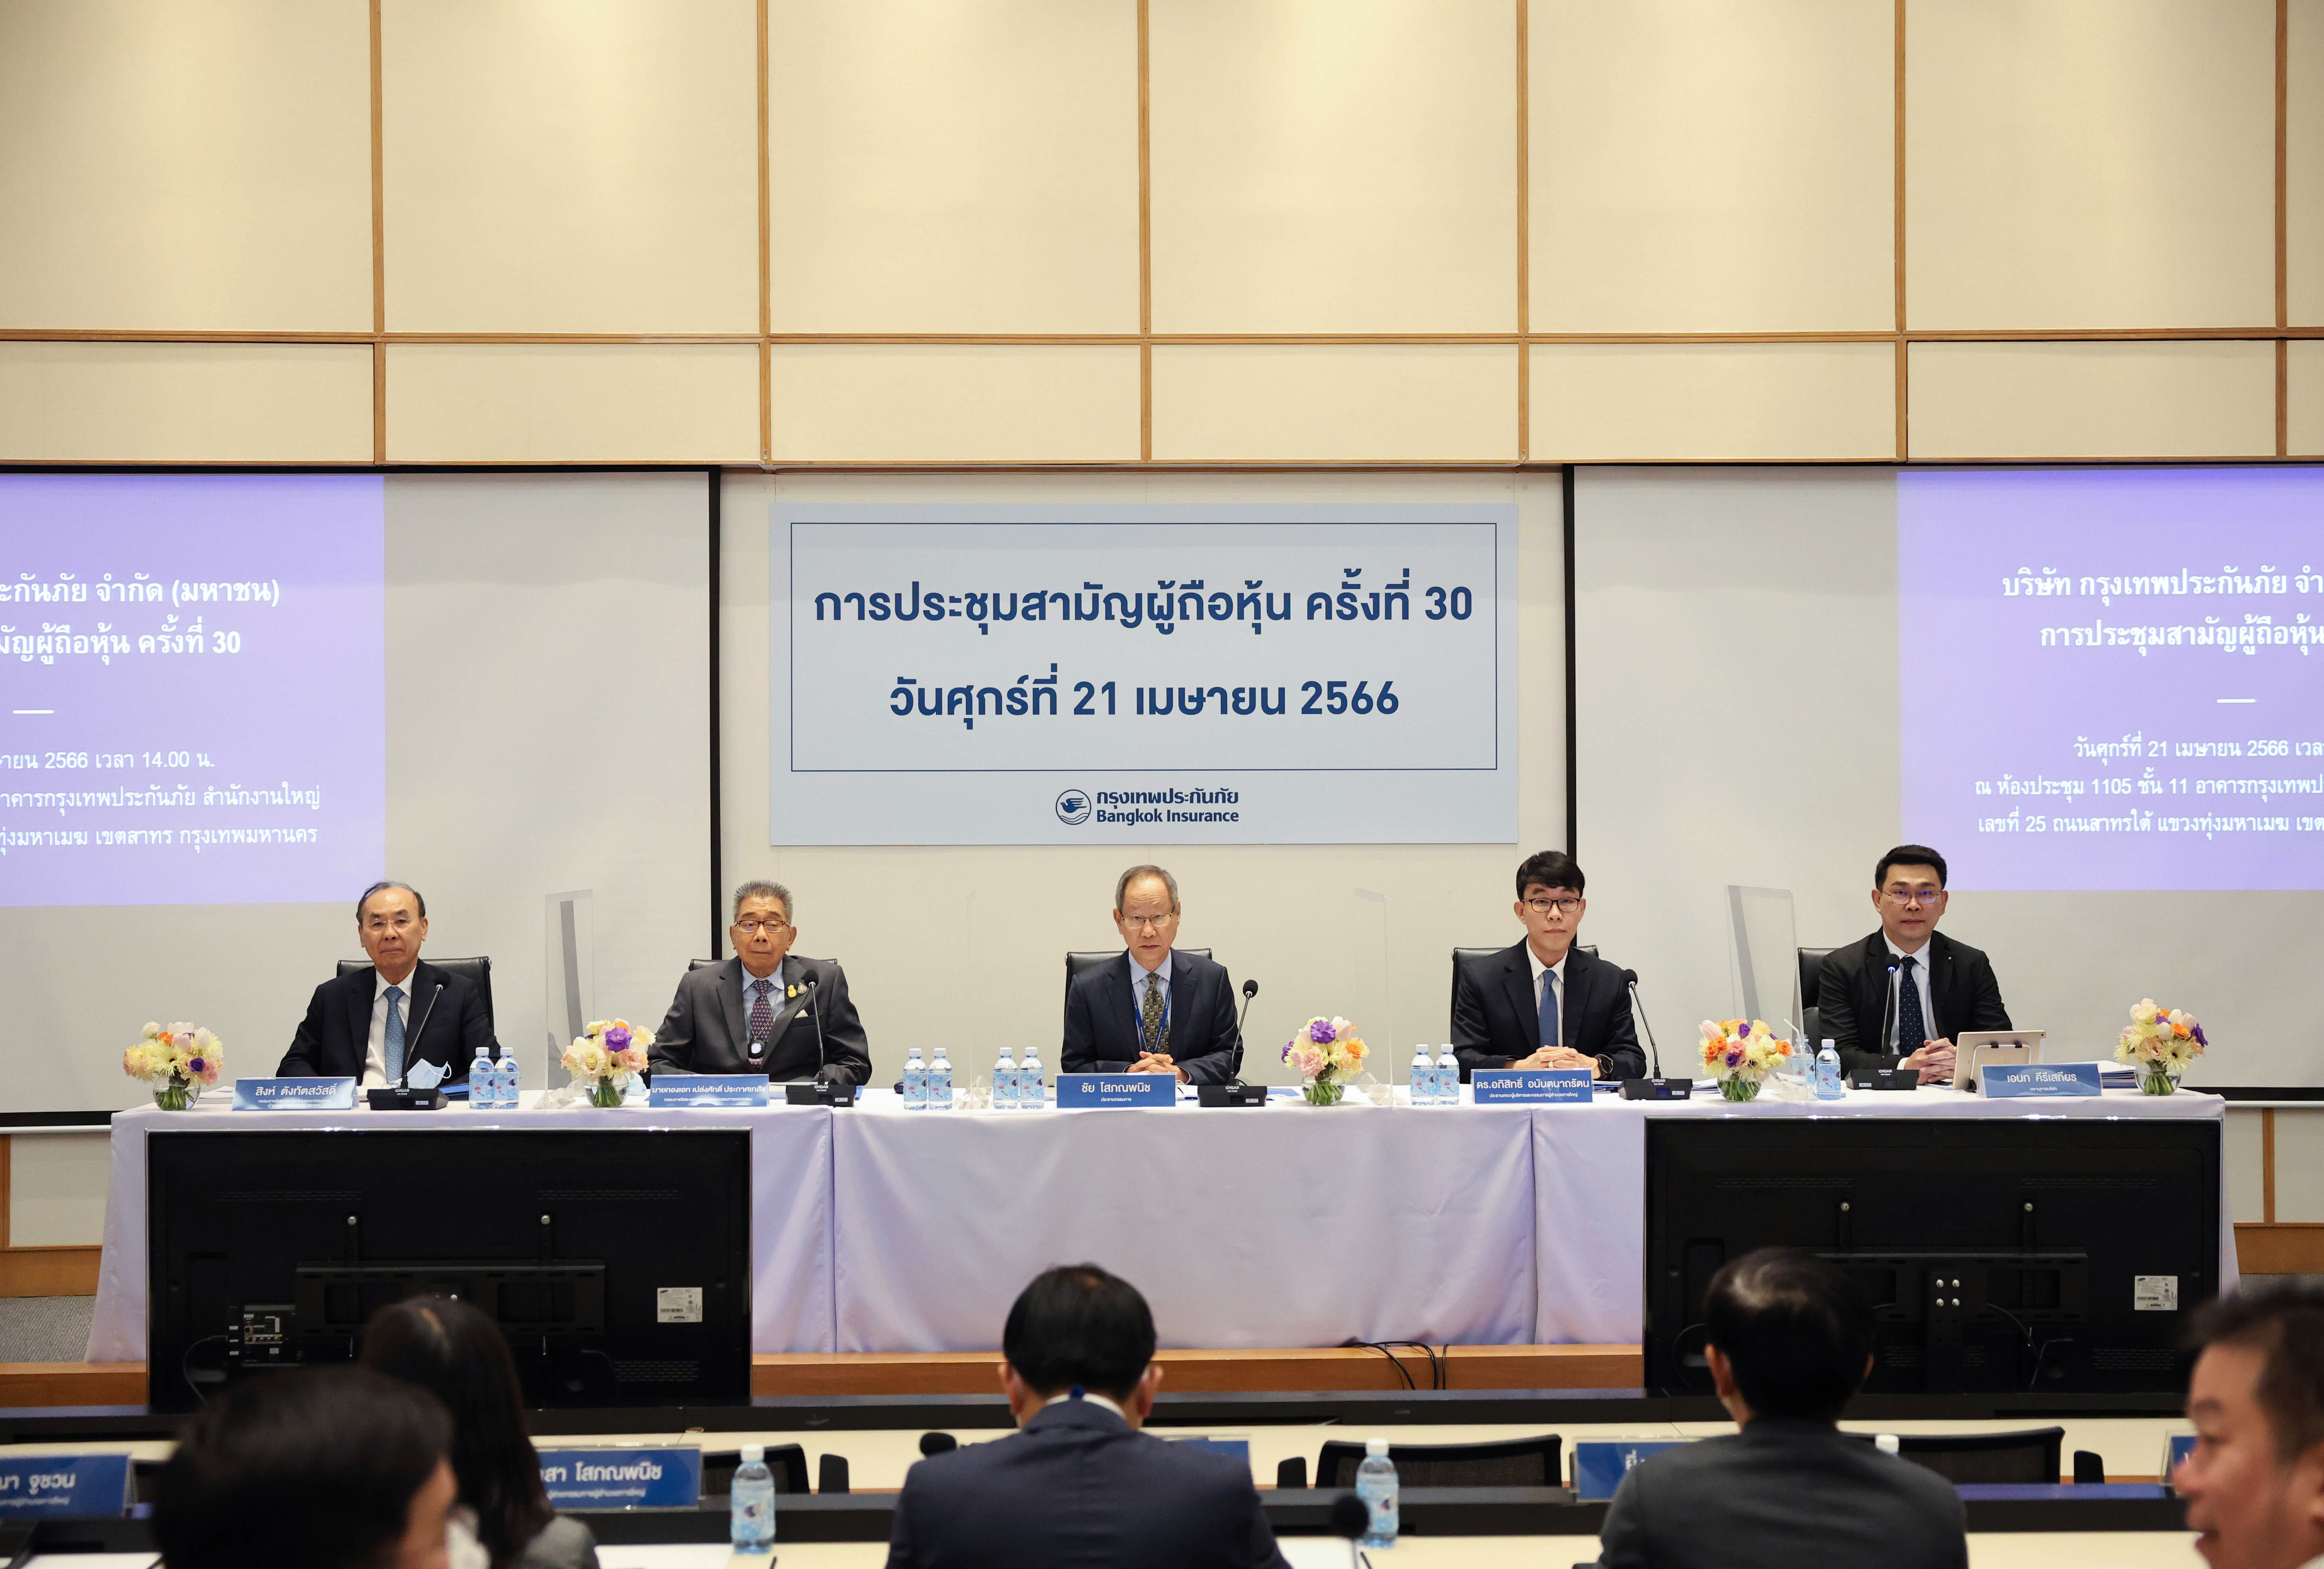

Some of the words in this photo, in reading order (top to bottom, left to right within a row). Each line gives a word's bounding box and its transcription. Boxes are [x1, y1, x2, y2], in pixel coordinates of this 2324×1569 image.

[95, 572, 163, 602] จำกัด
[172, 579, 280, 608] (มหาชน)
[2002, 567, 2070, 596] บริษัท
[2079, 565, 2287, 607] กรุงเทพประกันภัย
[814, 580, 1291, 636] การประชุมสามัญผู้ถือหุ้น
[1307, 568, 1410, 621] ครั้งที่
[1425, 586, 1472, 620] 30
[138, 614, 203, 653] ครั้งที่
[212, 631, 241, 653] 30
[2040, 613, 2324, 657] การประชุมสามัญผู้ถือหุ้น
[890, 663, 1058, 730] วันศุกร์ที่
[1073, 681, 1115, 715] 21
[1136, 687, 1285, 715] เมษายน
[1301, 681, 1399, 715] 2566
[0, 755, 38, 769] ายน
[44, 752, 88, 769] 2566
[96, 754, 134, 768] เวลา
[143, 751, 190, 768] 14.00
[196, 753, 214, 767] น.
[2073, 730, 2142, 766] วันศุกร์ที่
[2148, 741, 2166, 757] 21
[2175, 743, 2242, 757] เมษายน
[2247, 740, 2288, 757] 2566
[2296, 742, 2324, 756] เวล
[203, 781, 320, 810] สำนักงานใหญ่
[1097, 787, 1239, 809] กรุงเทพประกันภัย
[1975, 781, 1991, 795] ณ
[1997, 774, 2084, 804] ห้องประชุม
[2092, 778, 2132, 794] 1105
[2137, 767, 2163, 794] ชั้น
[2169, 778, 2186, 794] 11
[2196, 773, 2324, 803] อาคารกรุงเทพป
[1097, 807, 1163, 826] Bangkok
[1167, 809, 1239, 822] Insurance
[1979, 805, 2019, 832] เลขที่
[2025, 816, 2046, 832] 25
[2052, 808, 2153, 832] ถนนสาทรใต้
[2158, 812, 2289, 840] แขวงทุ่งมหาเมฆ
[96, 830, 173, 845] เขตสาทร
[179, 828, 318, 853] กรุงเทพมหานคร
[256, 1086, 276, 1096] สิงห์
[1081, 1082, 1095, 1092] ชัย
[1100, 1082, 1150, 1092] โสภณพนิช
[1477, 1077, 1523, 1089] ดร.อภิสิทธิ์
[1528, 1078, 1589, 1088] อนันตนาถรัตน
[2007, 1074, 2031, 1083] เอนก
[2035, 1071, 2077, 1082] คีรีเสถียร
[575, 1460, 663, 1482] โสภณพนิช
